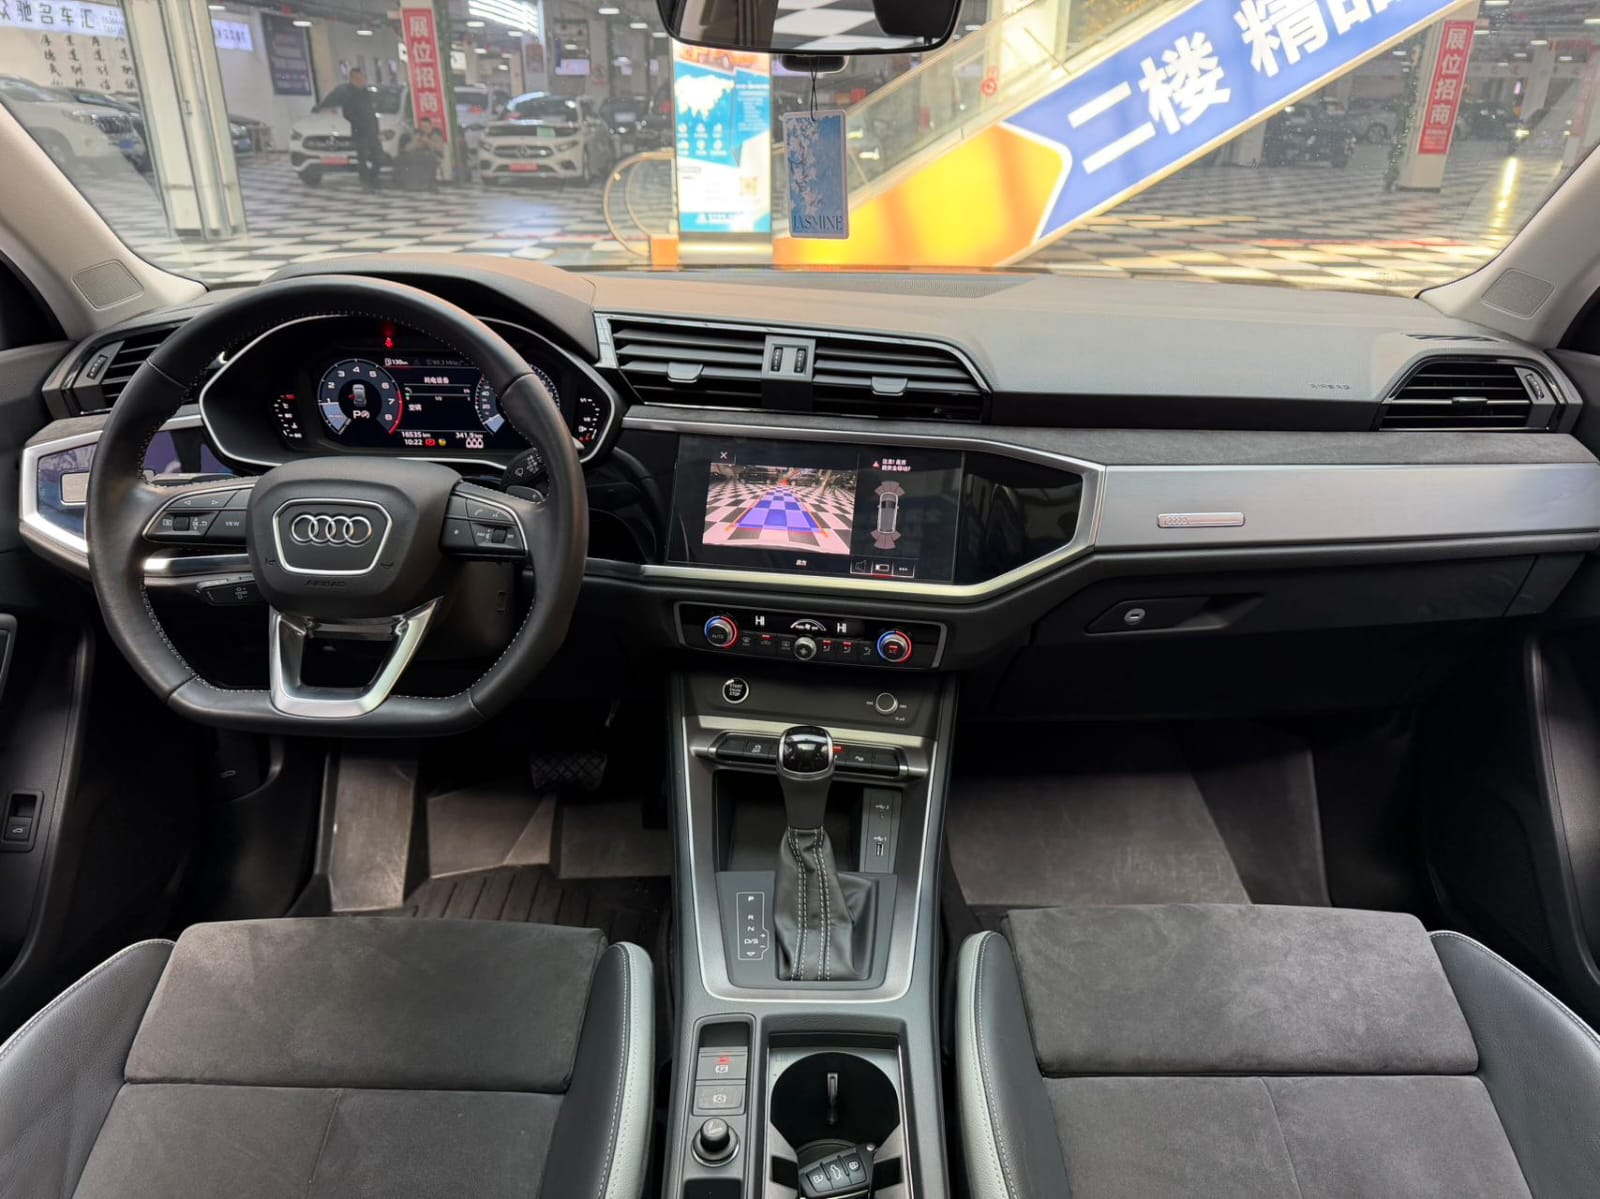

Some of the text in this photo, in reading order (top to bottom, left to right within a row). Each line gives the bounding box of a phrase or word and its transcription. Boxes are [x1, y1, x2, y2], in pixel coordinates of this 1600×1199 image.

[409, 16, 439, 113] 展位招商
[1429, 28, 1468, 126] 展位招商
[1067, 32, 1231, 175] 二楼
[793, 214, 844, 231] JASMINE
[755, 615, 765, 626] HI
[837, 622, 847, 633] HI
